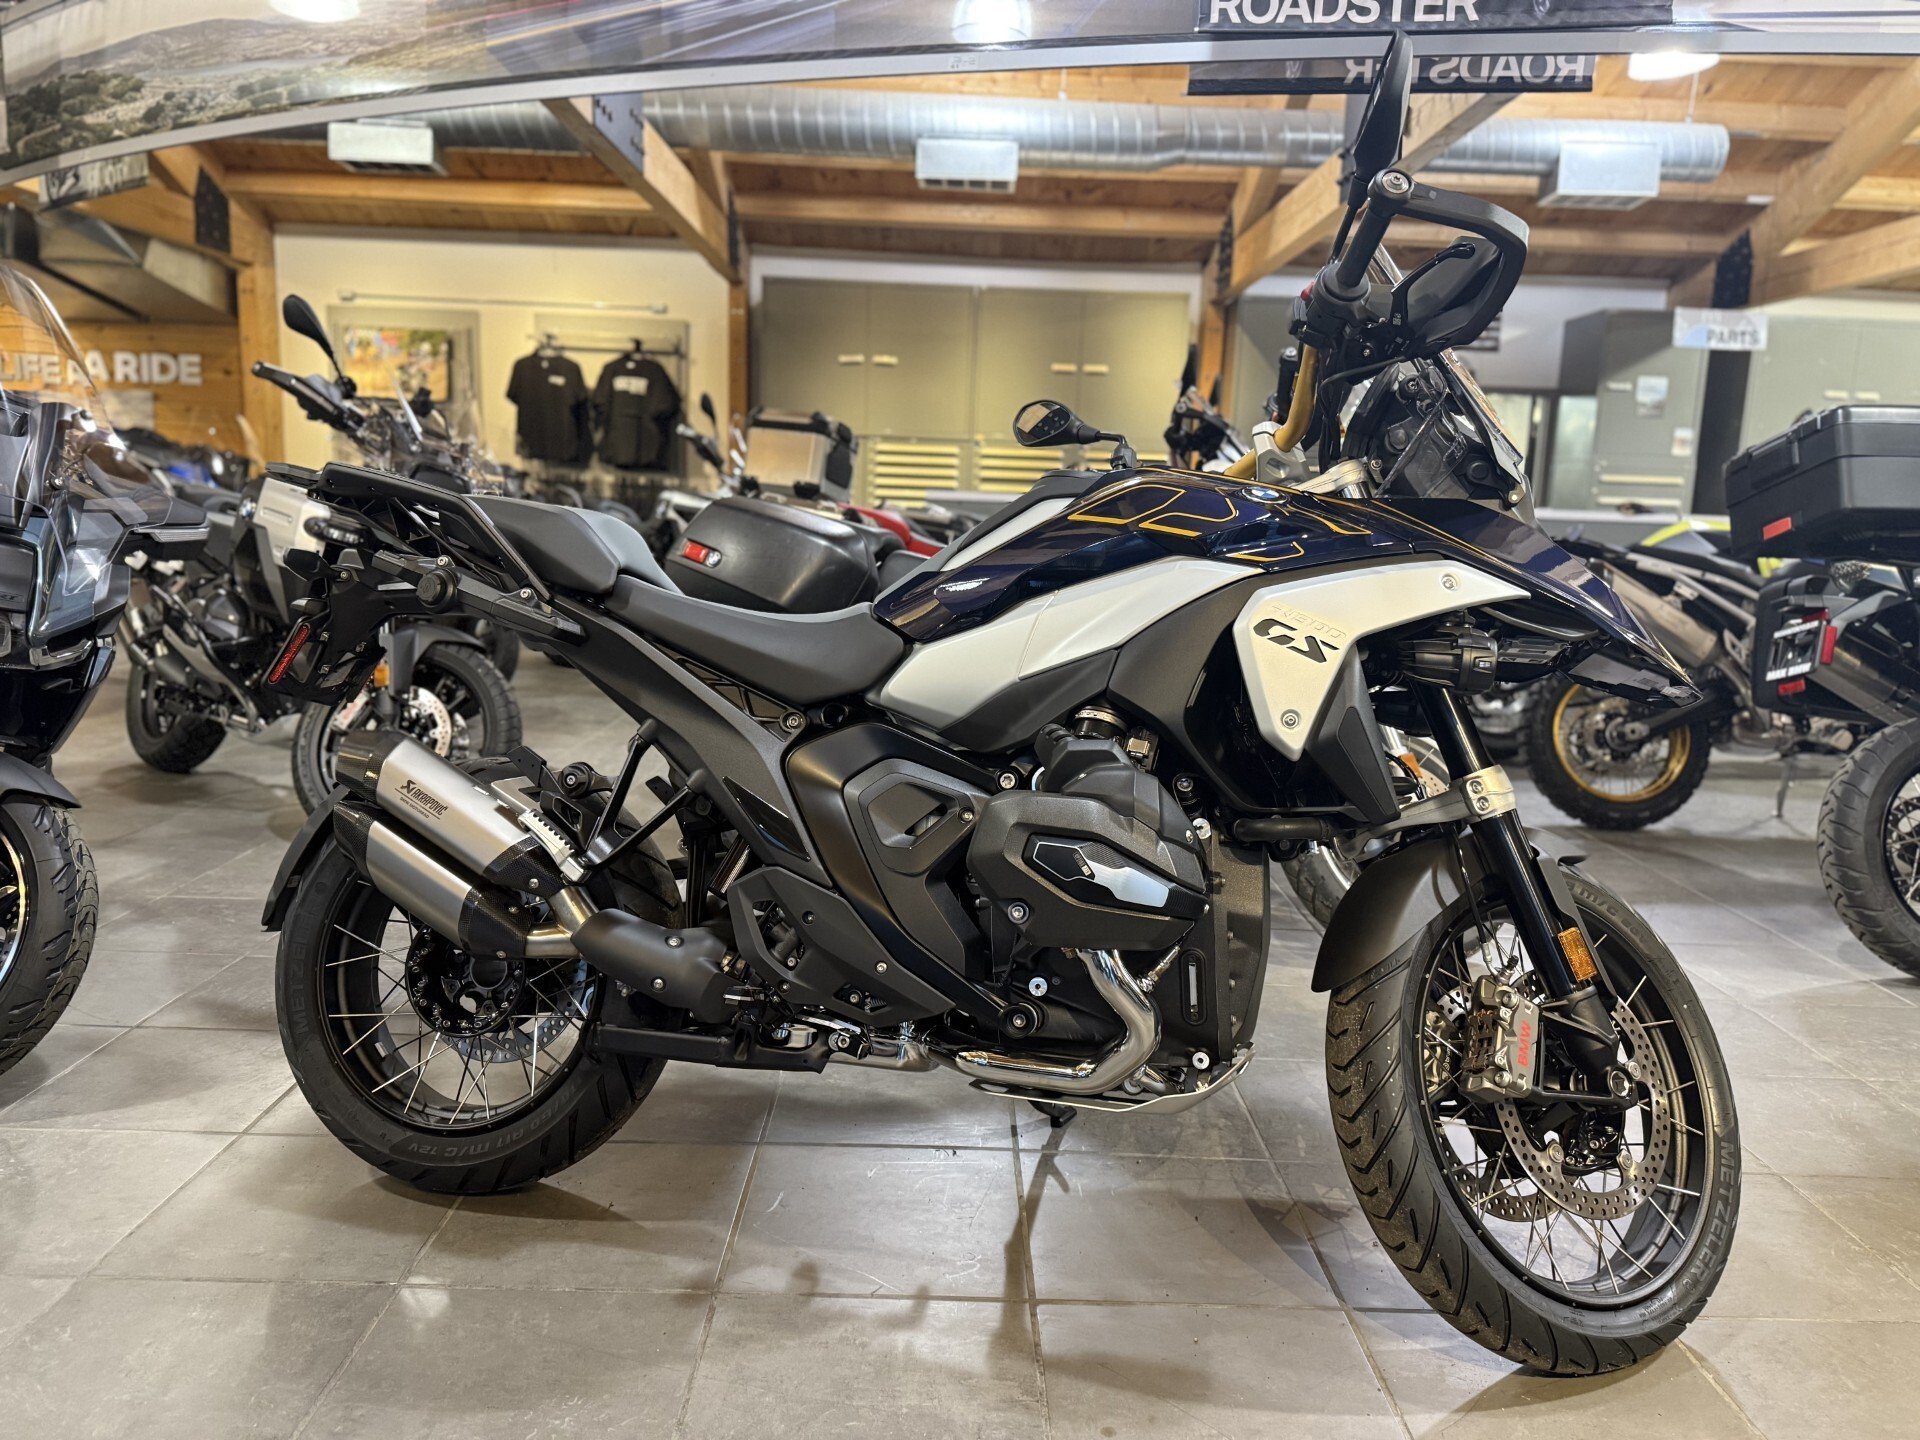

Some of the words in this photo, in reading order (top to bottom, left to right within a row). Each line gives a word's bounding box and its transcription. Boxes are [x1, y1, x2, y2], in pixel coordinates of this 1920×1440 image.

[1209, 0, 1480, 24] ROADSTER
[1707, 328, 1760, 346] PARTS
[1, 353, 62, 385] LIFE
[113, 351, 202, 385] RIDE
[1253, 617, 1340, 664] GS
[1517, 1020, 1532, 1067] BMW
[1691, 1140, 1735, 1286] METZELER
